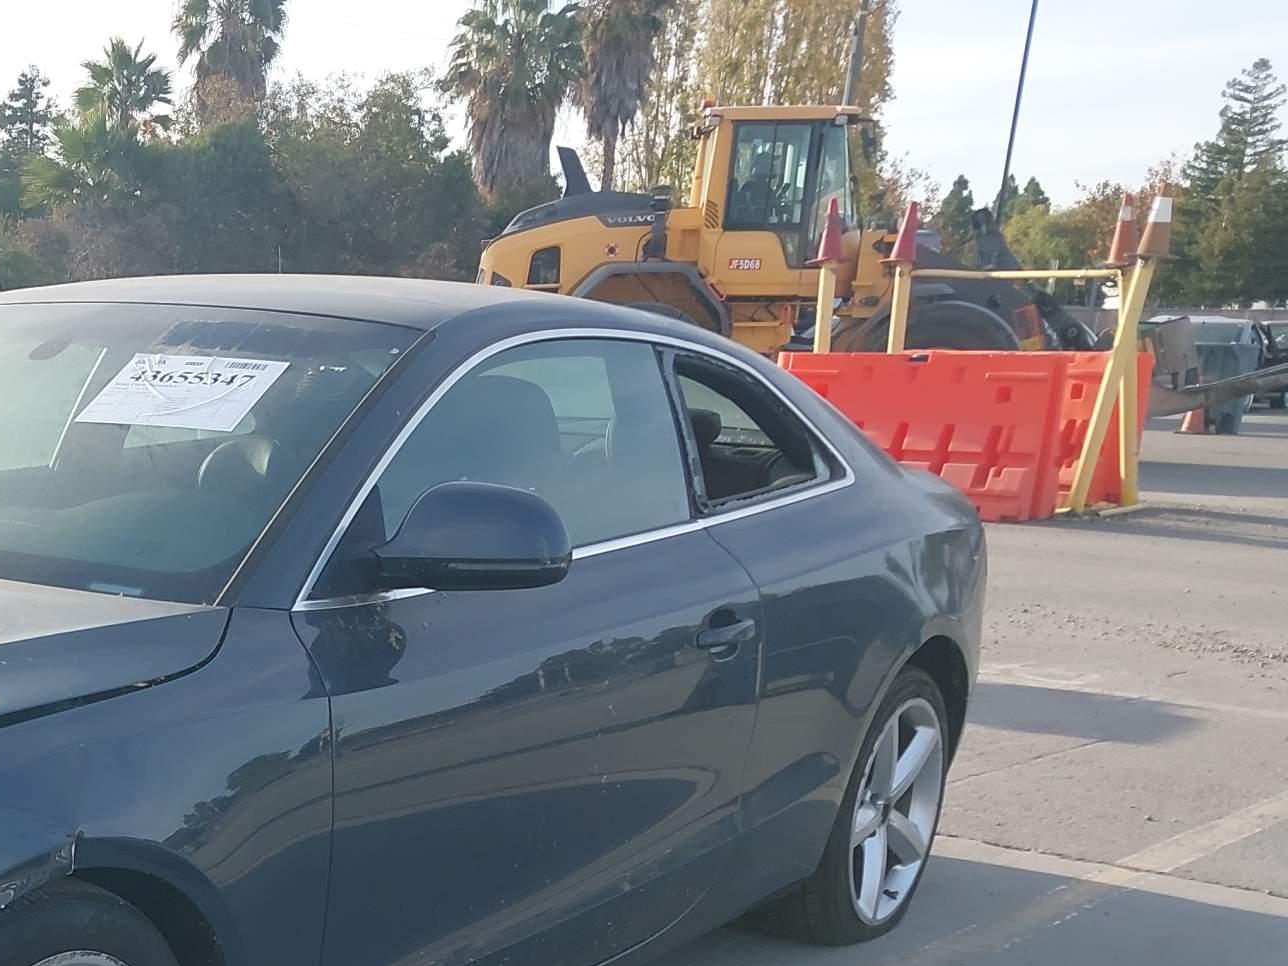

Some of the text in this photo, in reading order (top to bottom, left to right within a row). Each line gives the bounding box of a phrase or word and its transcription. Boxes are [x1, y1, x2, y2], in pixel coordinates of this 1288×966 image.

[607, 214, 655, 224] VOLVO
[729, 259, 761, 269] JF5D68
[129, 370, 257, 388] 43655347
